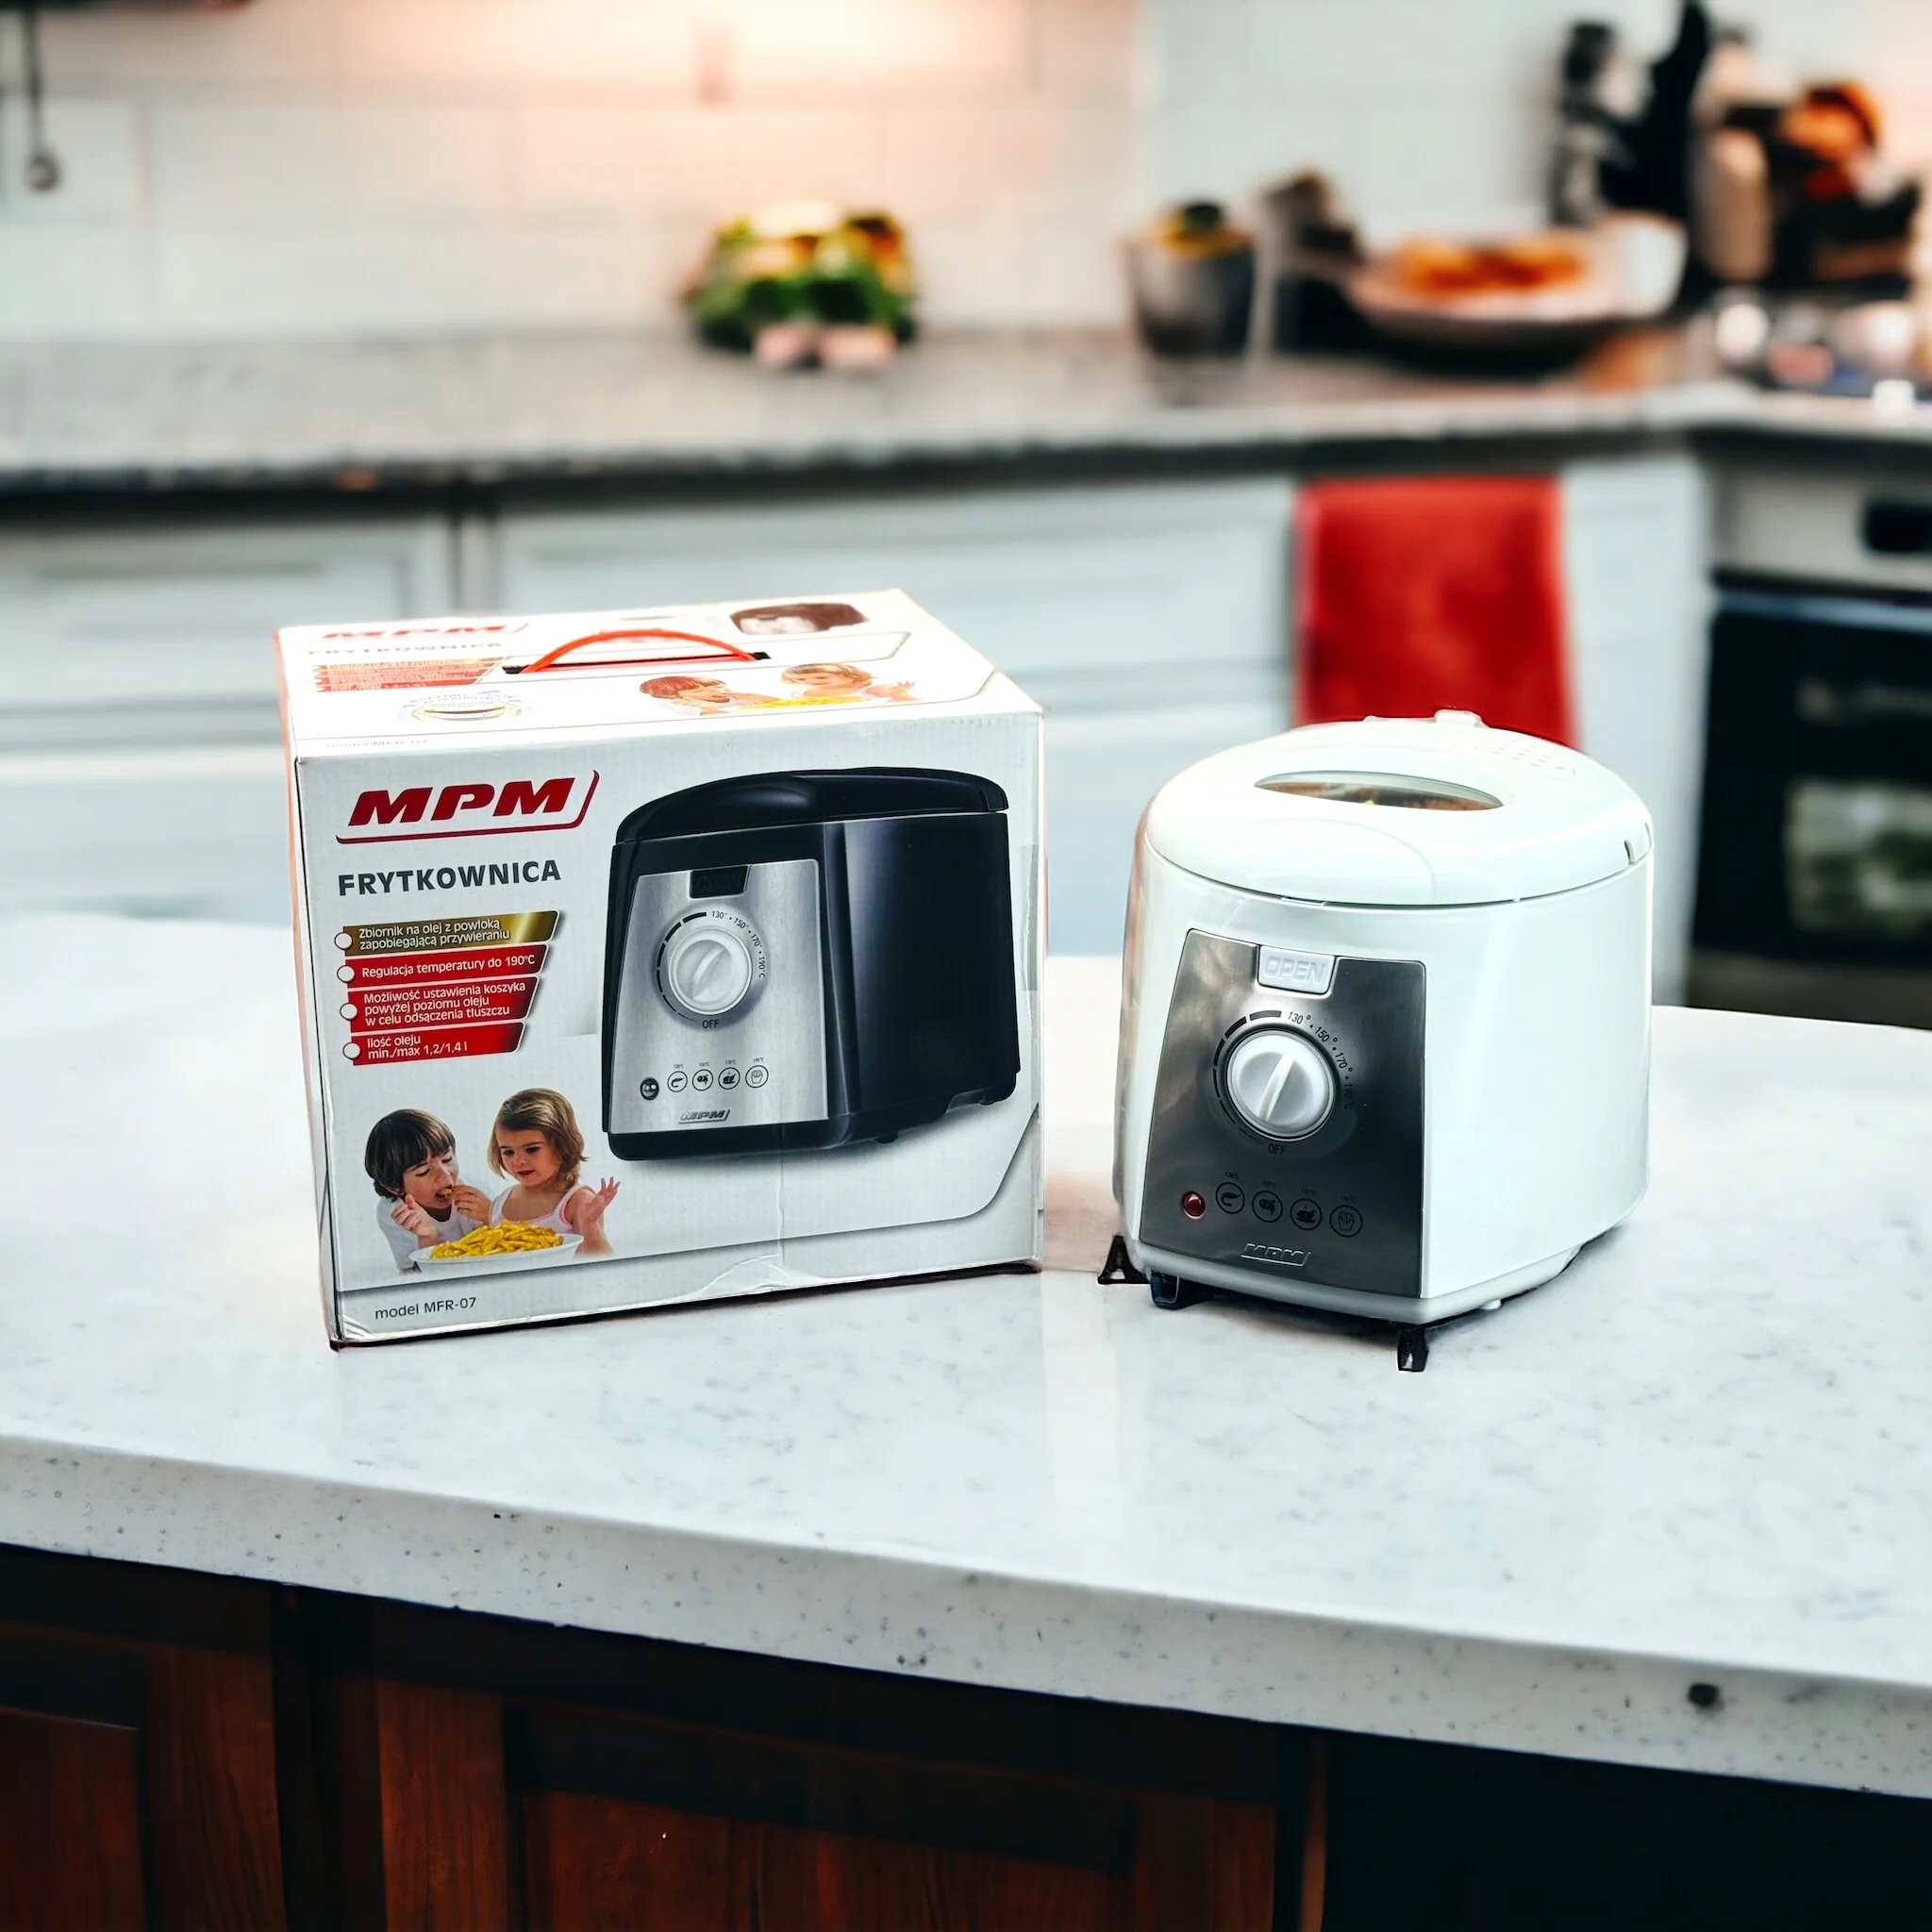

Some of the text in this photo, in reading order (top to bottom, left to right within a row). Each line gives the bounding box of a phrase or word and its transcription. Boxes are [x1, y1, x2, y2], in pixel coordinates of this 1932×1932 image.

[348, 777, 575, 826] MPM
[339, 859, 561, 896] FRYTKOWNICA
[358, 925, 404, 939] Zbiornik
[407, 925, 420, 935] na
[423, 923, 442, 935] olej
[444, 924, 452, 932] z
[440, 929, 510, 946] przywieraniu
[361, 963, 414, 978] Regulacja
[416, 959, 485, 974] temperatury
[488, 958, 502, 968] do
[1263, 956, 1326, 983] OPEN
[424, 985, 481, 999] ustawienia
[483, 981, 526, 994] koszyka
[364, 995, 490, 1017] powyżej poziomu oleju
[365, 1017, 376, 1026] w
[378, 1014, 402, 1025] celu
[404, 1008, 464, 1024] odsączenia
[702, 1019, 720, 1029] OFF
[393, 1034, 422, 1046] oleju
[368, 1047, 421, 1059] min./max
[423, 1041, 461, 1056] 1,2/1,4
[680, 1109, 727, 1121] MPM
[1268, 1143, 1288, 1156] OFF
[375, 1296, 476, 1320] model MFR-07
